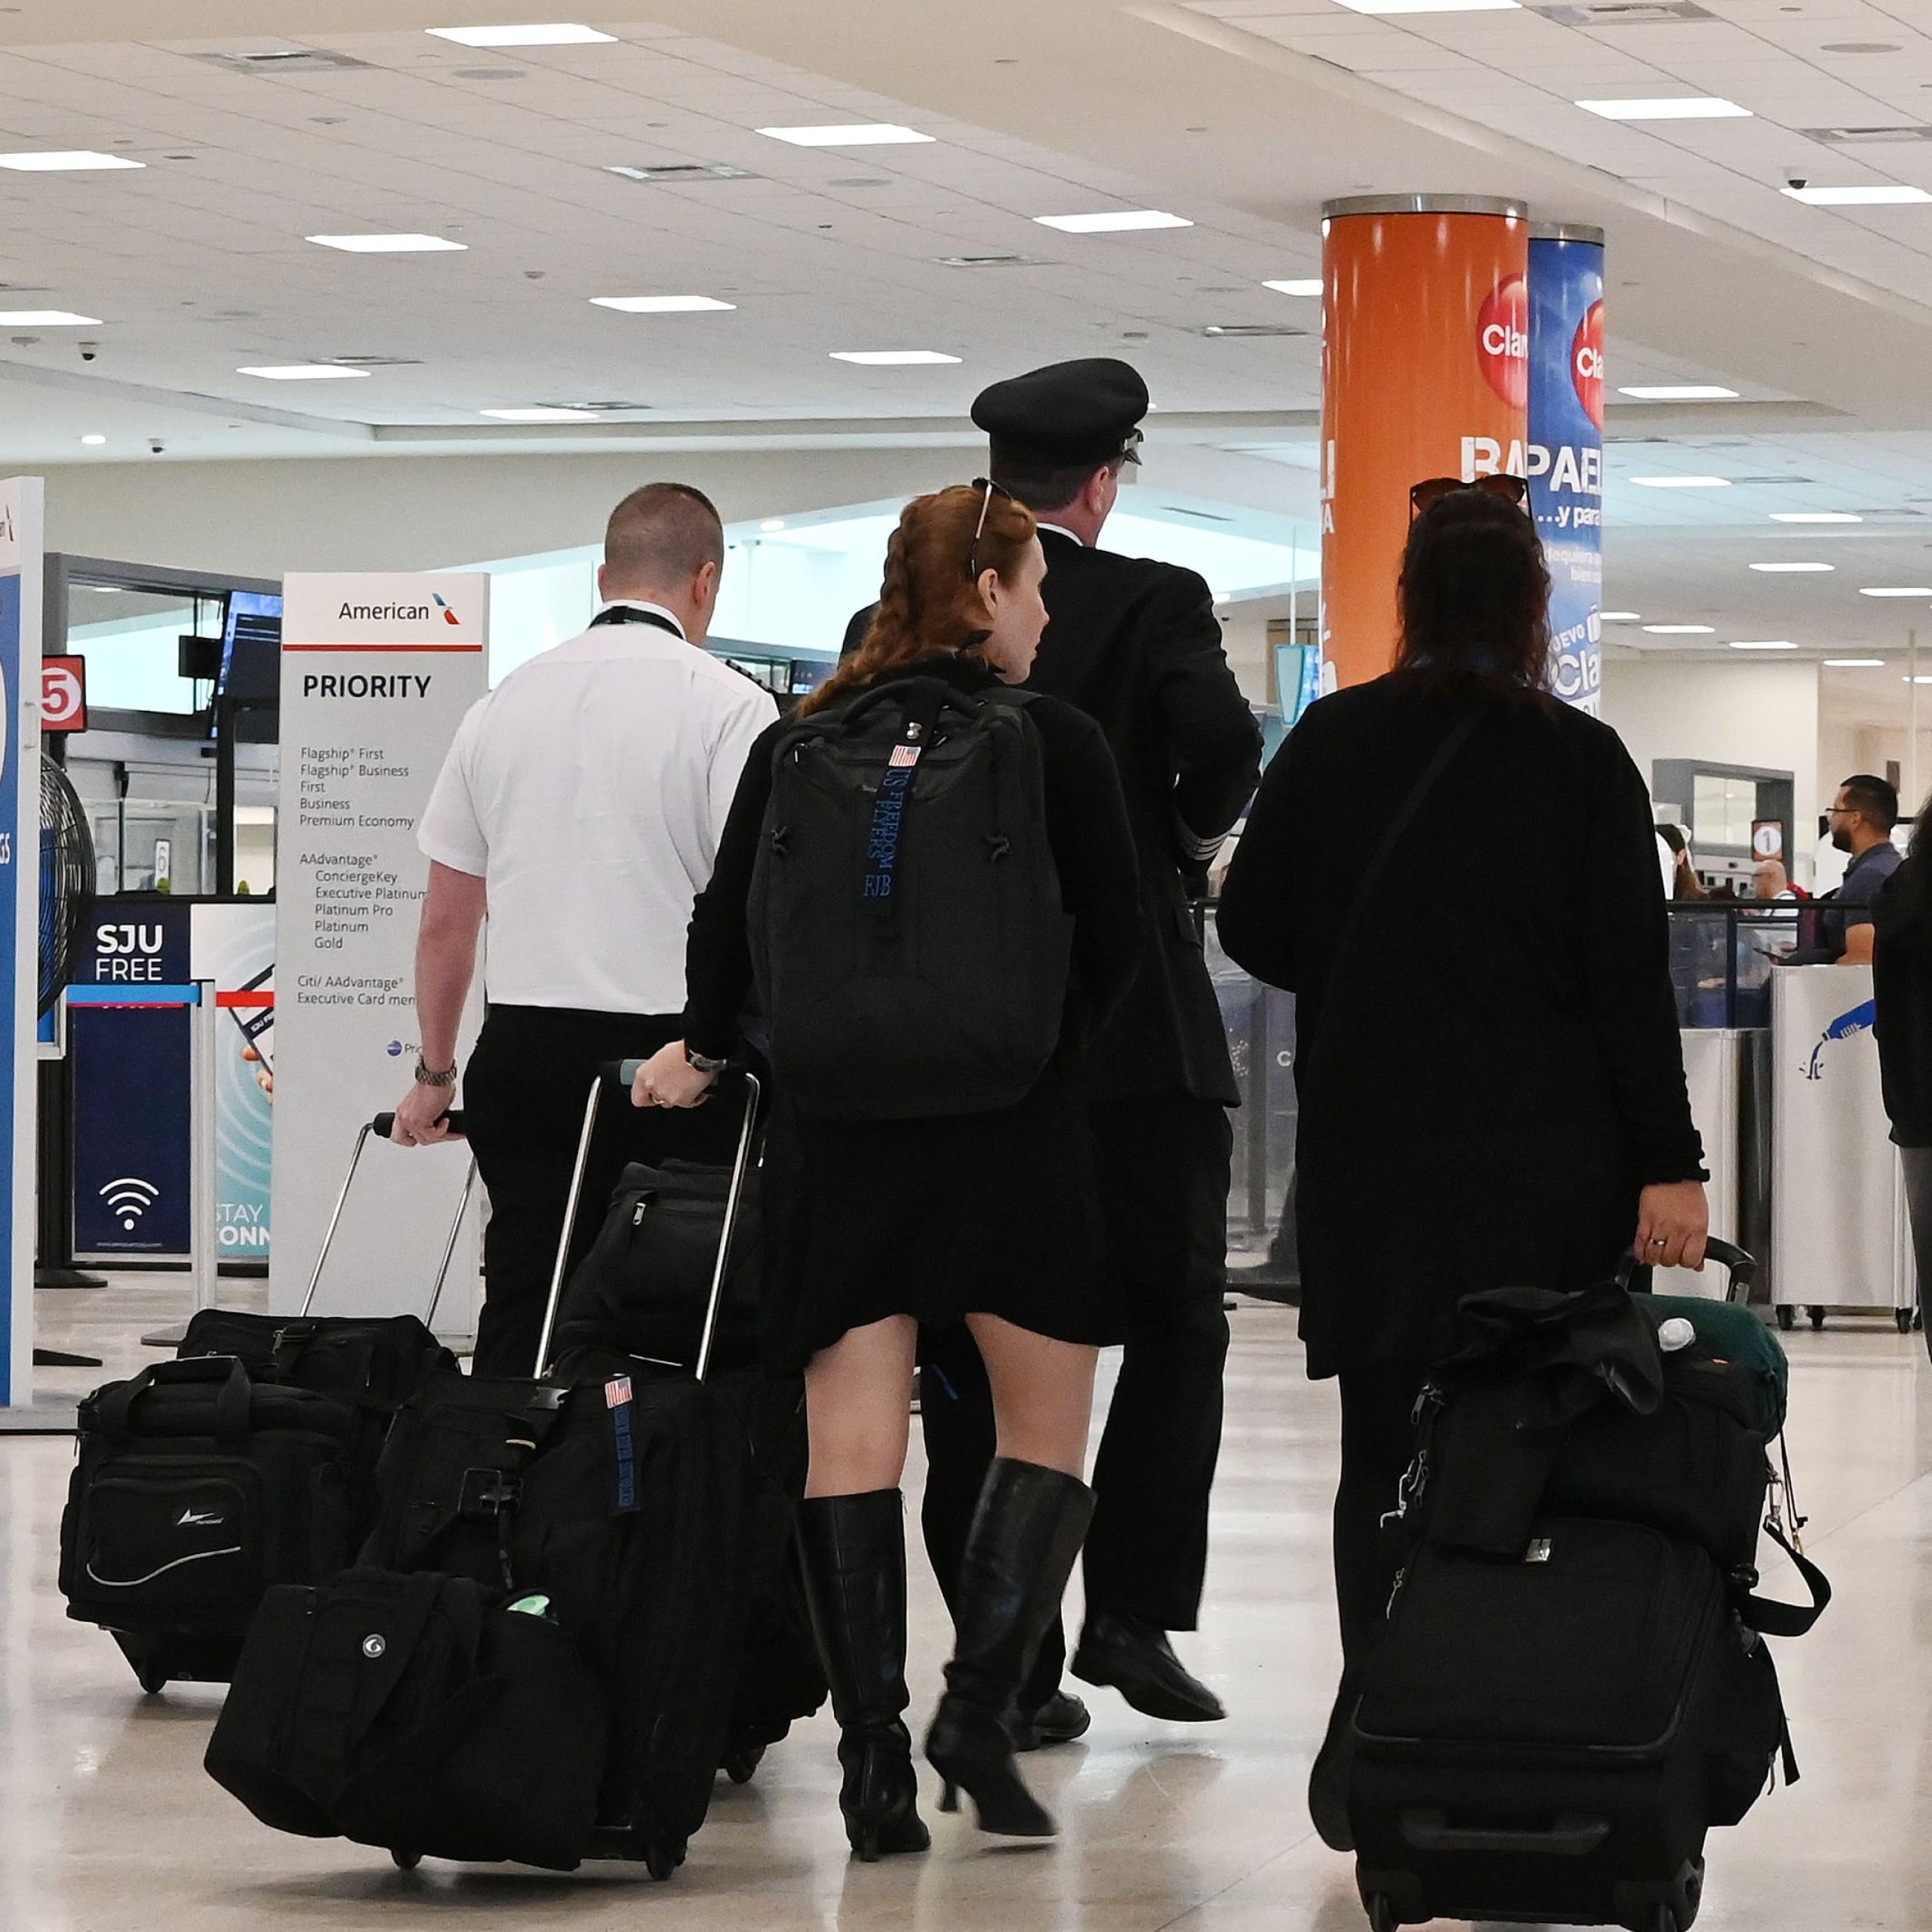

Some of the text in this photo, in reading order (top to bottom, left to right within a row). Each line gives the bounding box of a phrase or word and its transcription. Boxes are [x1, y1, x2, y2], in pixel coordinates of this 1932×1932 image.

[339, 602, 429, 620] American
[303, 675, 431, 698] PRIORITY
[42, 674, 69, 715] 5
[359, 748, 383, 760] First
[358, 764, 409, 777] Business
[300, 780, 325, 792] First
[300, 798, 350, 809] Business
[300, 814, 414, 830] Premium Economy
[879, 792, 903, 869] FREEDOM
[315, 870, 398, 885] ConciergeKey
[315, 886, 372, 899] Executive
[315, 903, 393, 916] Platinum Pro
[315, 920, 369, 932] Platinum
[96, 924, 163, 954] SJU
[314, 937, 343, 949] Gold
[96, 958, 163, 980] FREE
[297, 992, 355, 1004] Executive
[357, 992, 385, 1004] Card
[217, 1203, 263, 1223] TAY
